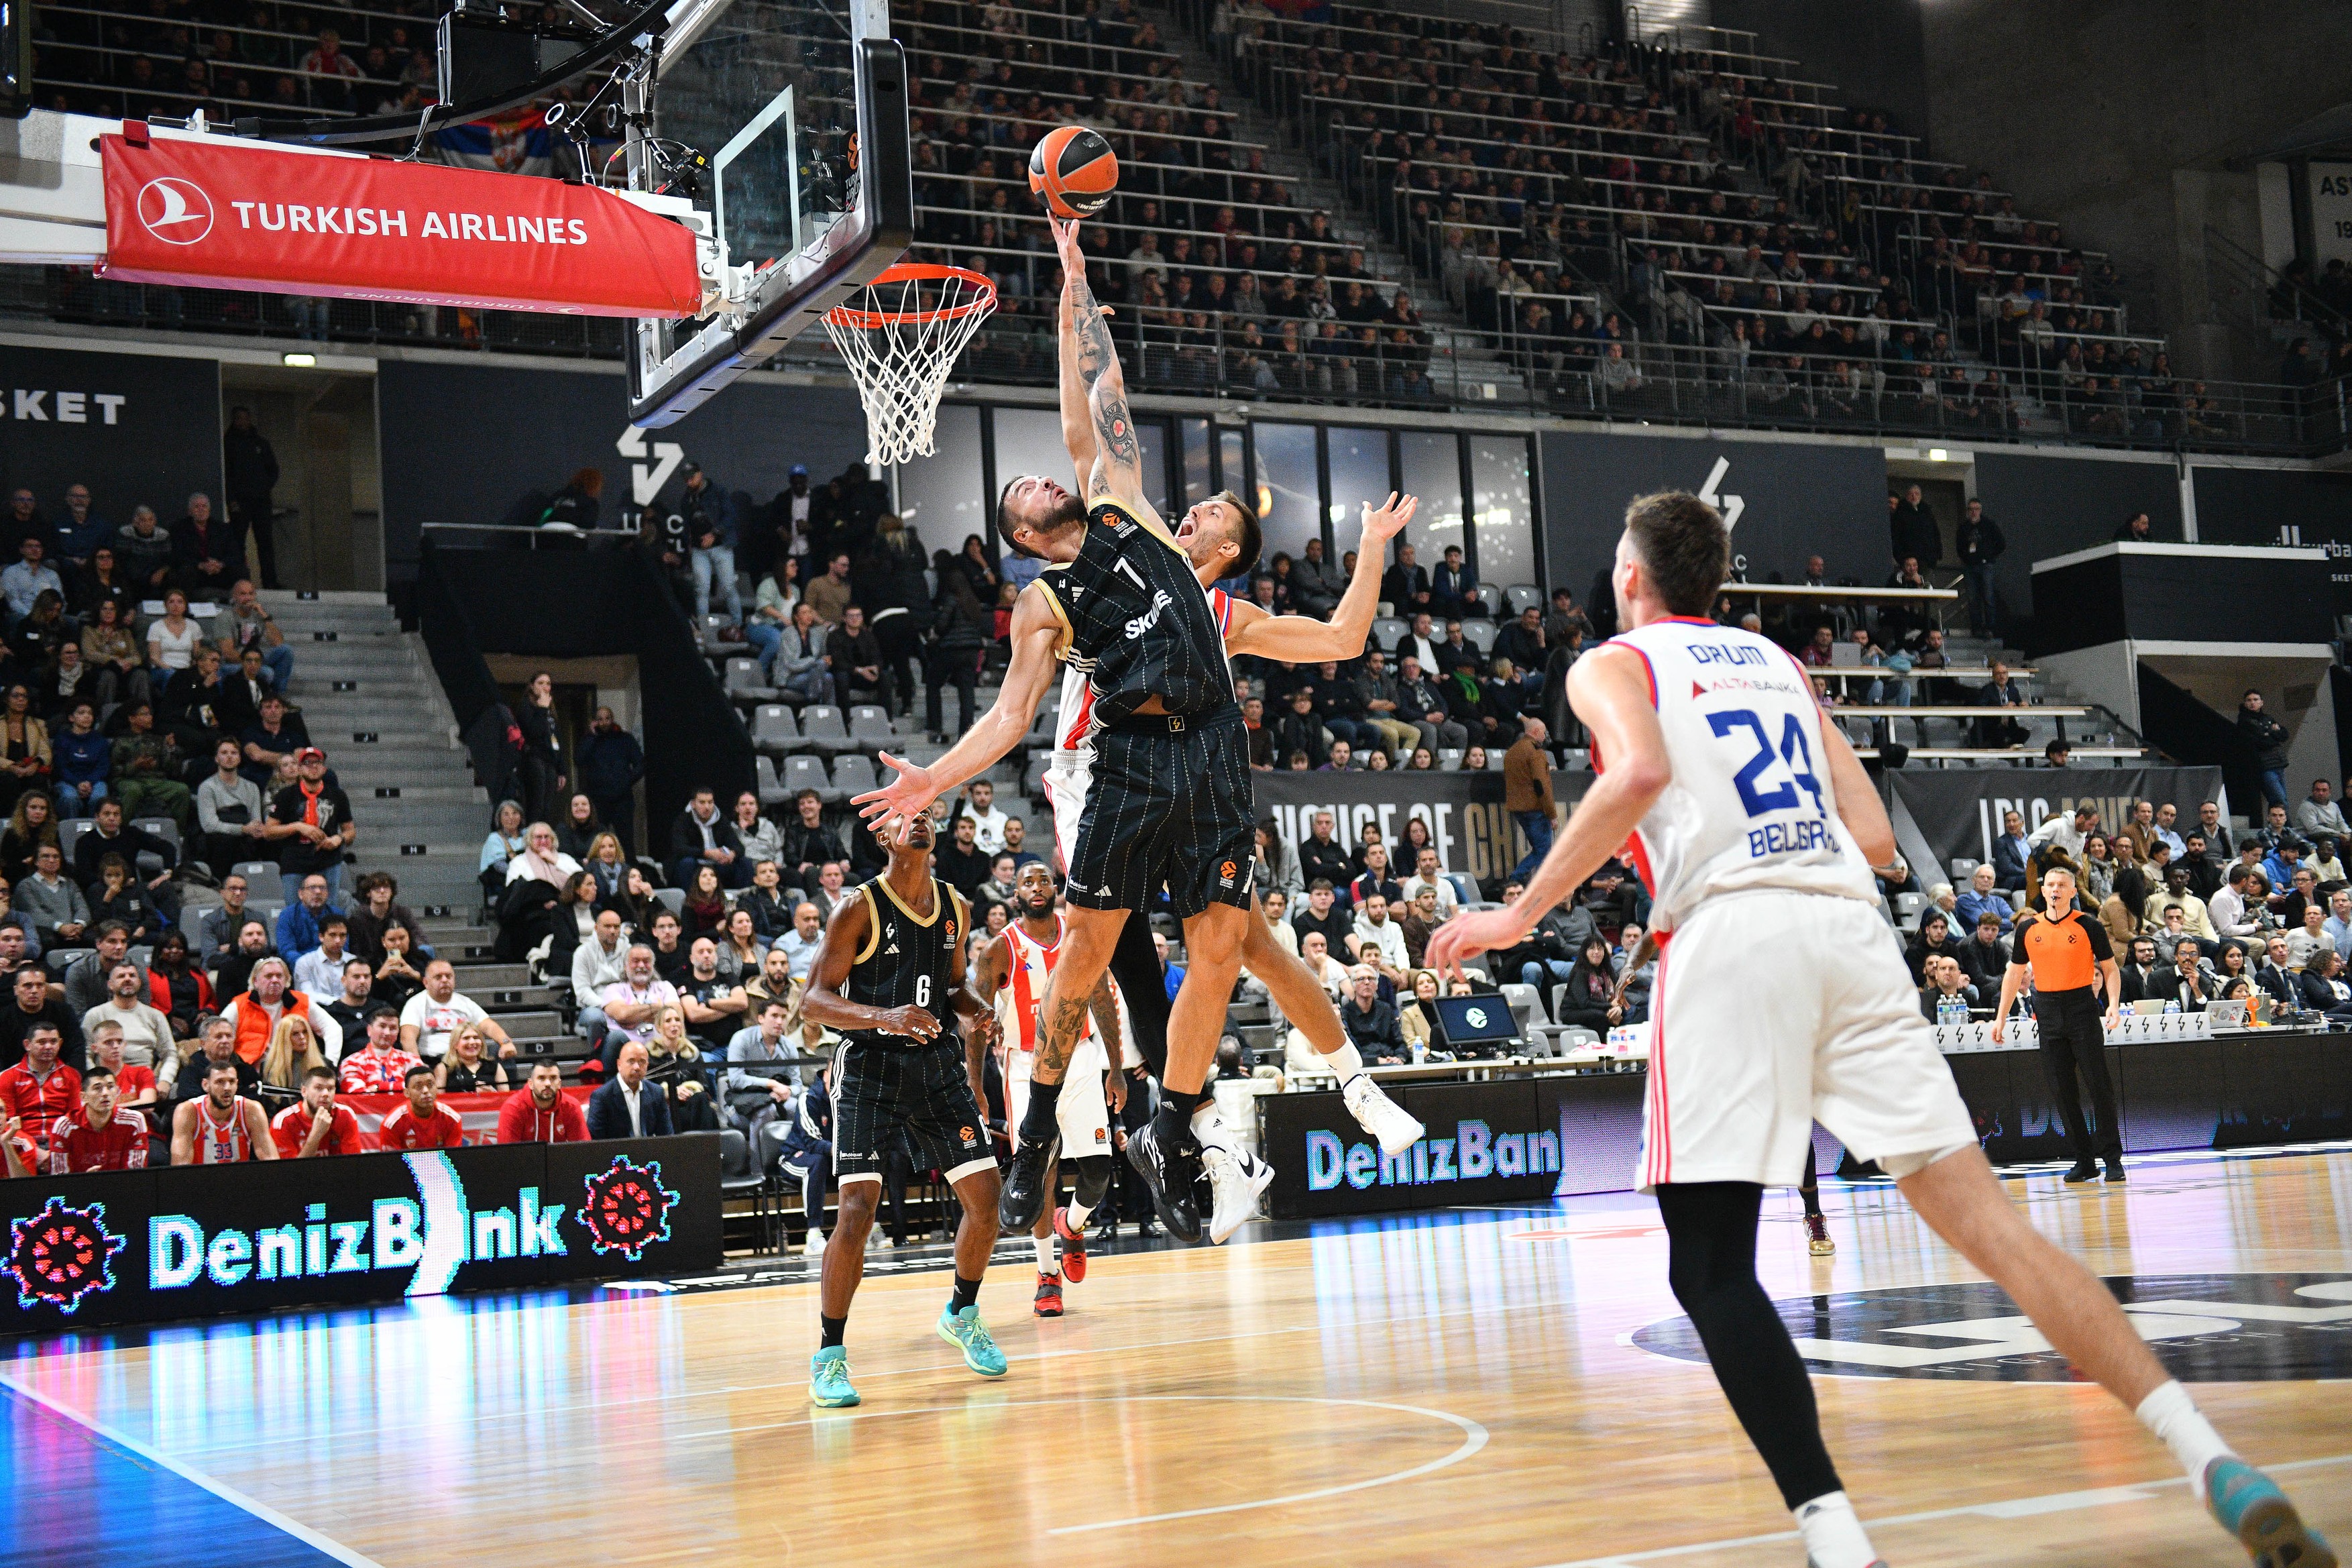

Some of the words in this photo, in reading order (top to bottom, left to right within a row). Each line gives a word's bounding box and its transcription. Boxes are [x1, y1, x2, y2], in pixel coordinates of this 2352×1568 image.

[2320, 175, 2352, 197] AS
[231, 201, 407, 237] TURKISH
[421, 212, 588, 245] AIRLINES
[343, 292, 441, 303] AIRLINES
[445, 300, 536, 311] TURKISH
[0, 389, 126, 425] KET
[1113, 557, 1146, 590] 7
[1686, 644, 1769, 665] DRUM
[1705, 709, 1828, 820] 24
[1242, 854, 1257, 894] 7
[915, 974, 931, 1007] 6
[536, 1044, 544, 1053] D
[213, 1143, 233, 1160] 33
[1305, 1120, 1563, 1191] DenizBan
[148, 1186, 567, 1291] DenizBnk
[2149, 1331, 2284, 1350] ECH
